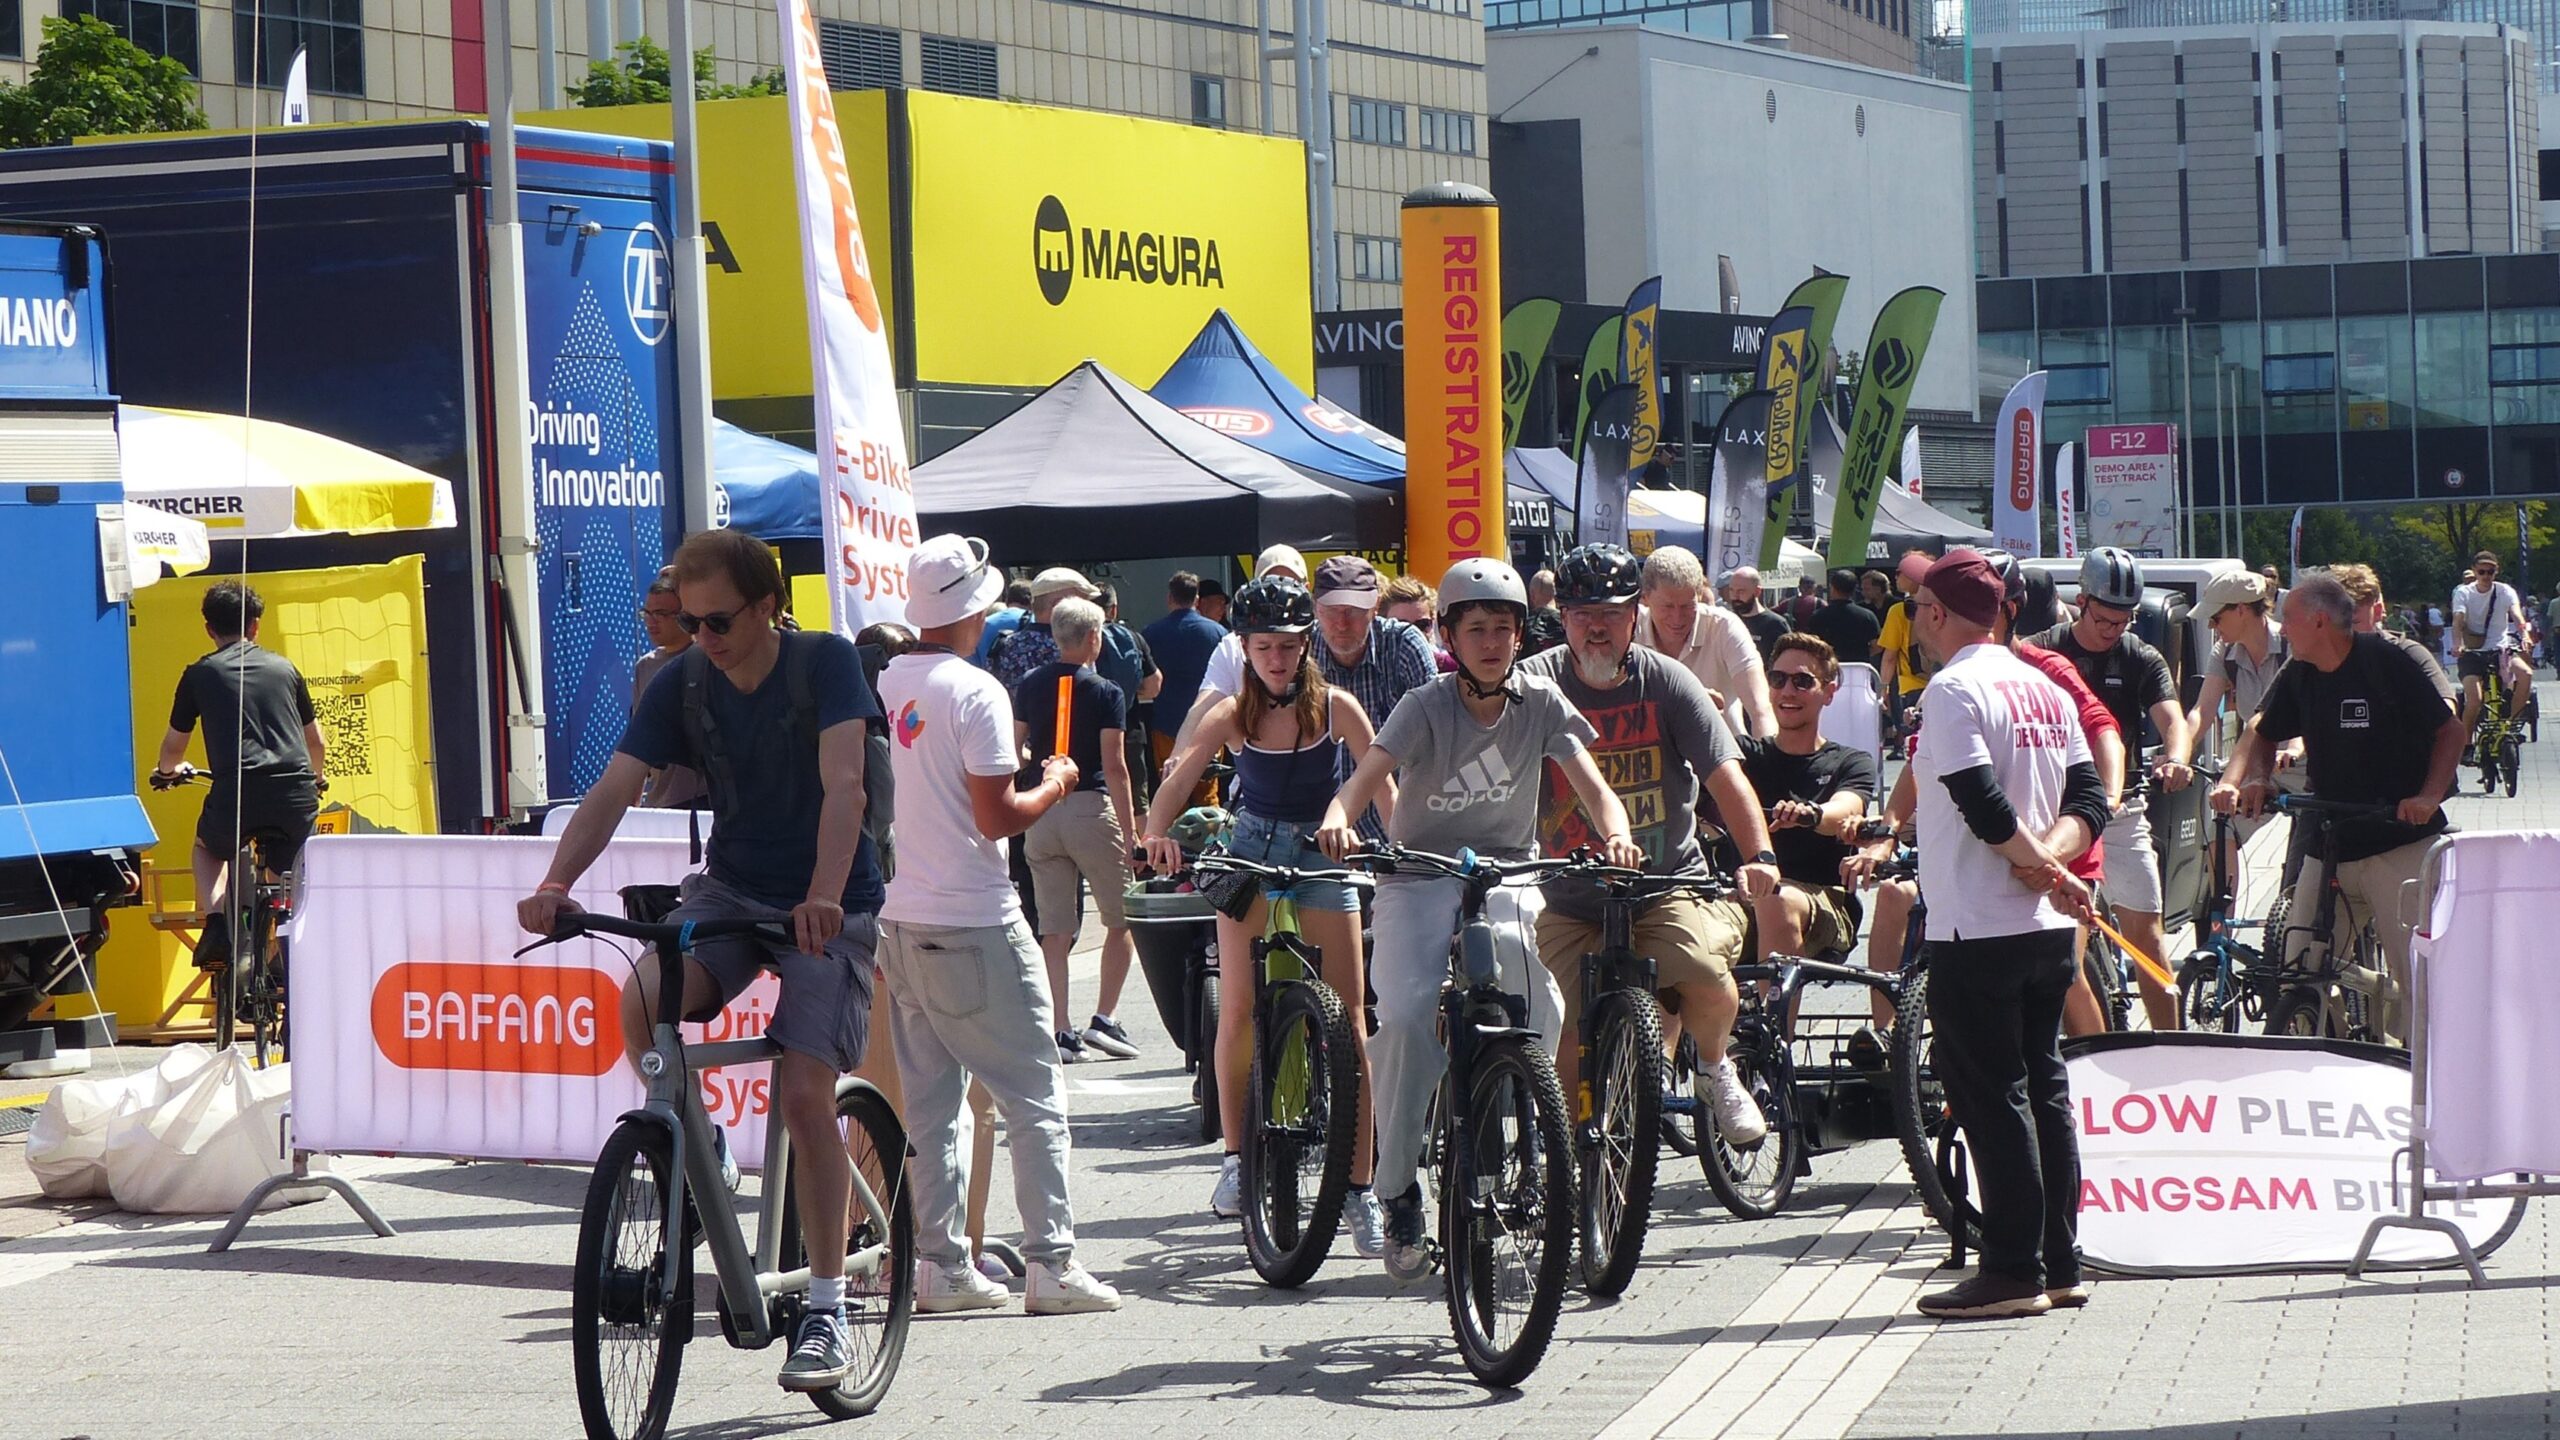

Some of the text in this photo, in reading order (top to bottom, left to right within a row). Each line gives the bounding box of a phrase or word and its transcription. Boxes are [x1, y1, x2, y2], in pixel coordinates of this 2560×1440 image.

[1081, 227, 1225, 289] MAGURA
[1443, 236, 1482, 560] REGISTRATIO
[529, 401, 600, 456] Driving
[1594, 421, 1630, 440] LAX
[1725, 428, 1765, 446] LAX
[2110, 431, 2146, 449] F12
[541, 458, 665, 508] Innovation
[835, 435, 911, 496] E-Bike
[2018, 420, 2030, 499] BAFANG
[2094, 464, 2125, 473] DEMO
[2127, 463, 2156, 472] AREA
[2095, 473, 2157, 483] TEST TRACK
[1993, 680, 2067, 725] TEAM
[404, 991, 595, 1046] BAFANG
[2067, 1094, 2218, 1135] LOW
